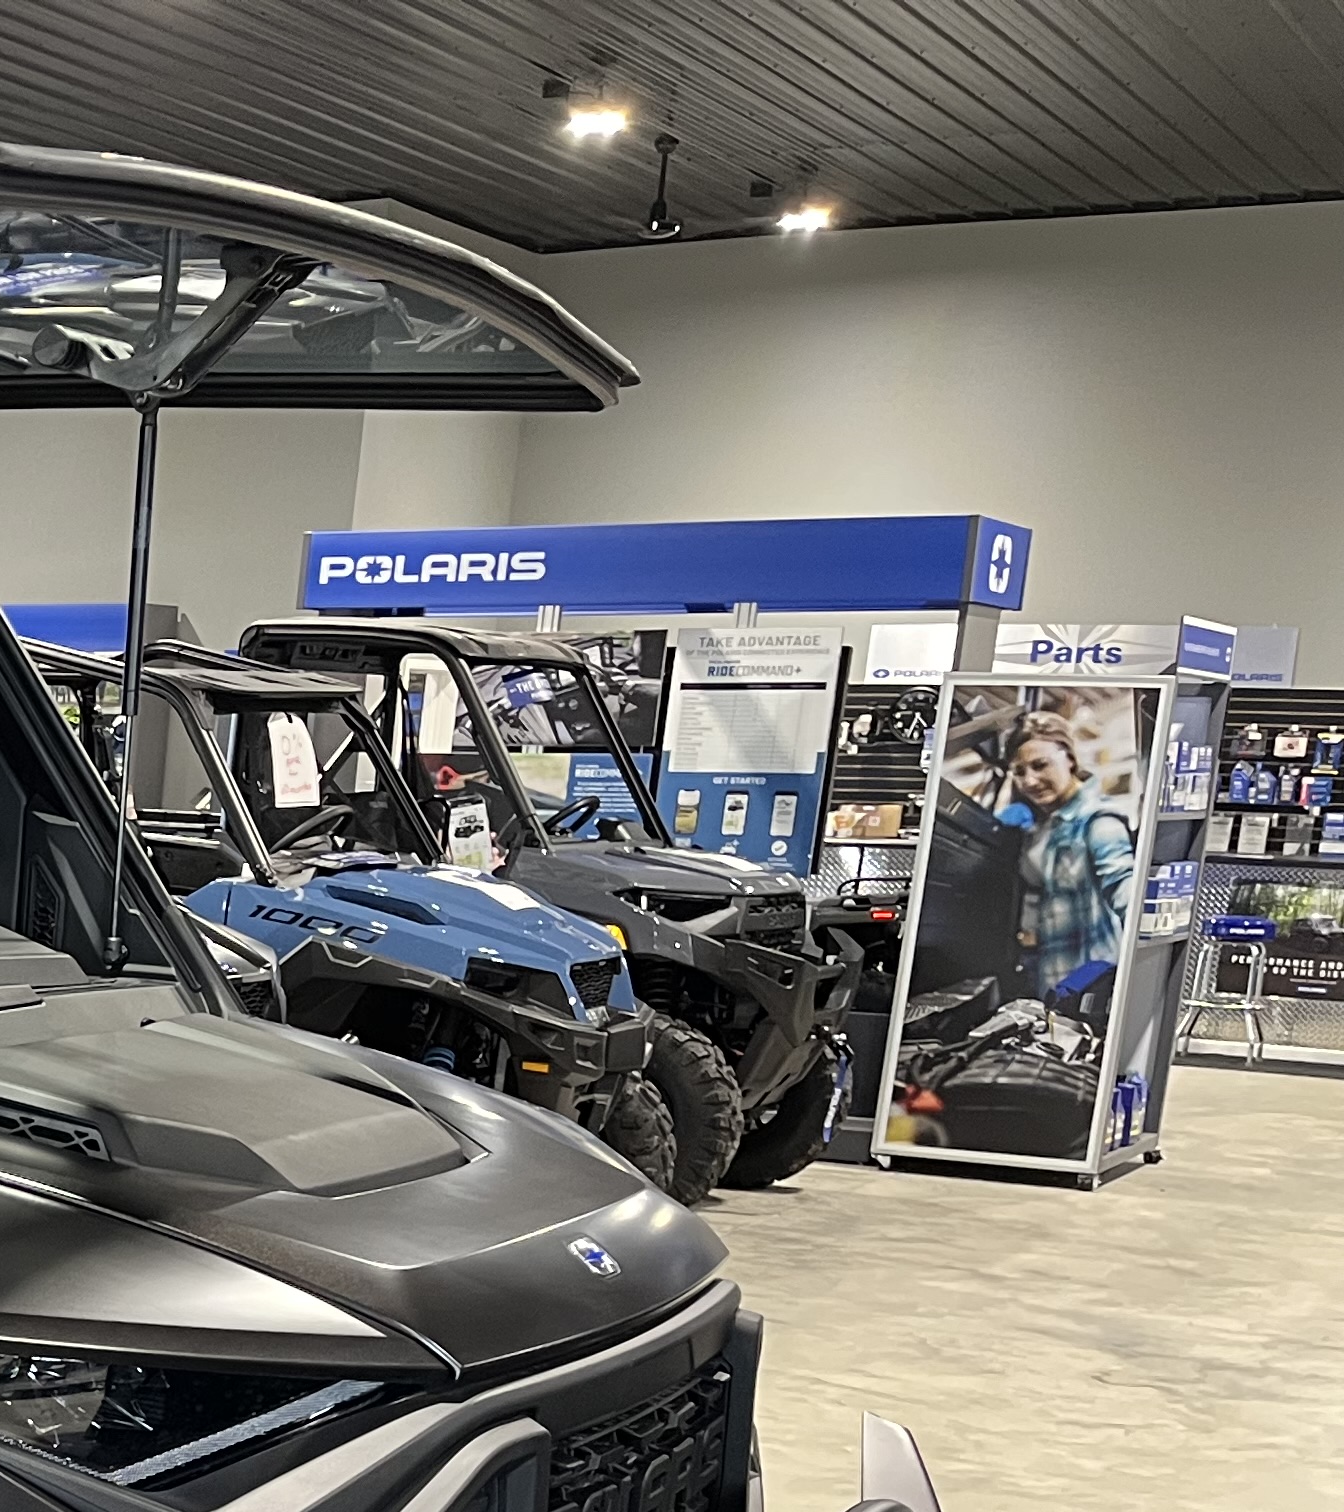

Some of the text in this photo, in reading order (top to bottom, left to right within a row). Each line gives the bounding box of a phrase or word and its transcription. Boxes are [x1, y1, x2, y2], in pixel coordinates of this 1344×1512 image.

[318, 550, 546, 585] POLARIS
[699, 635, 822, 648] TAKE ADVANTAGE
[1029, 639, 1123, 664] Parts
[248, 904, 385, 944] 1000
